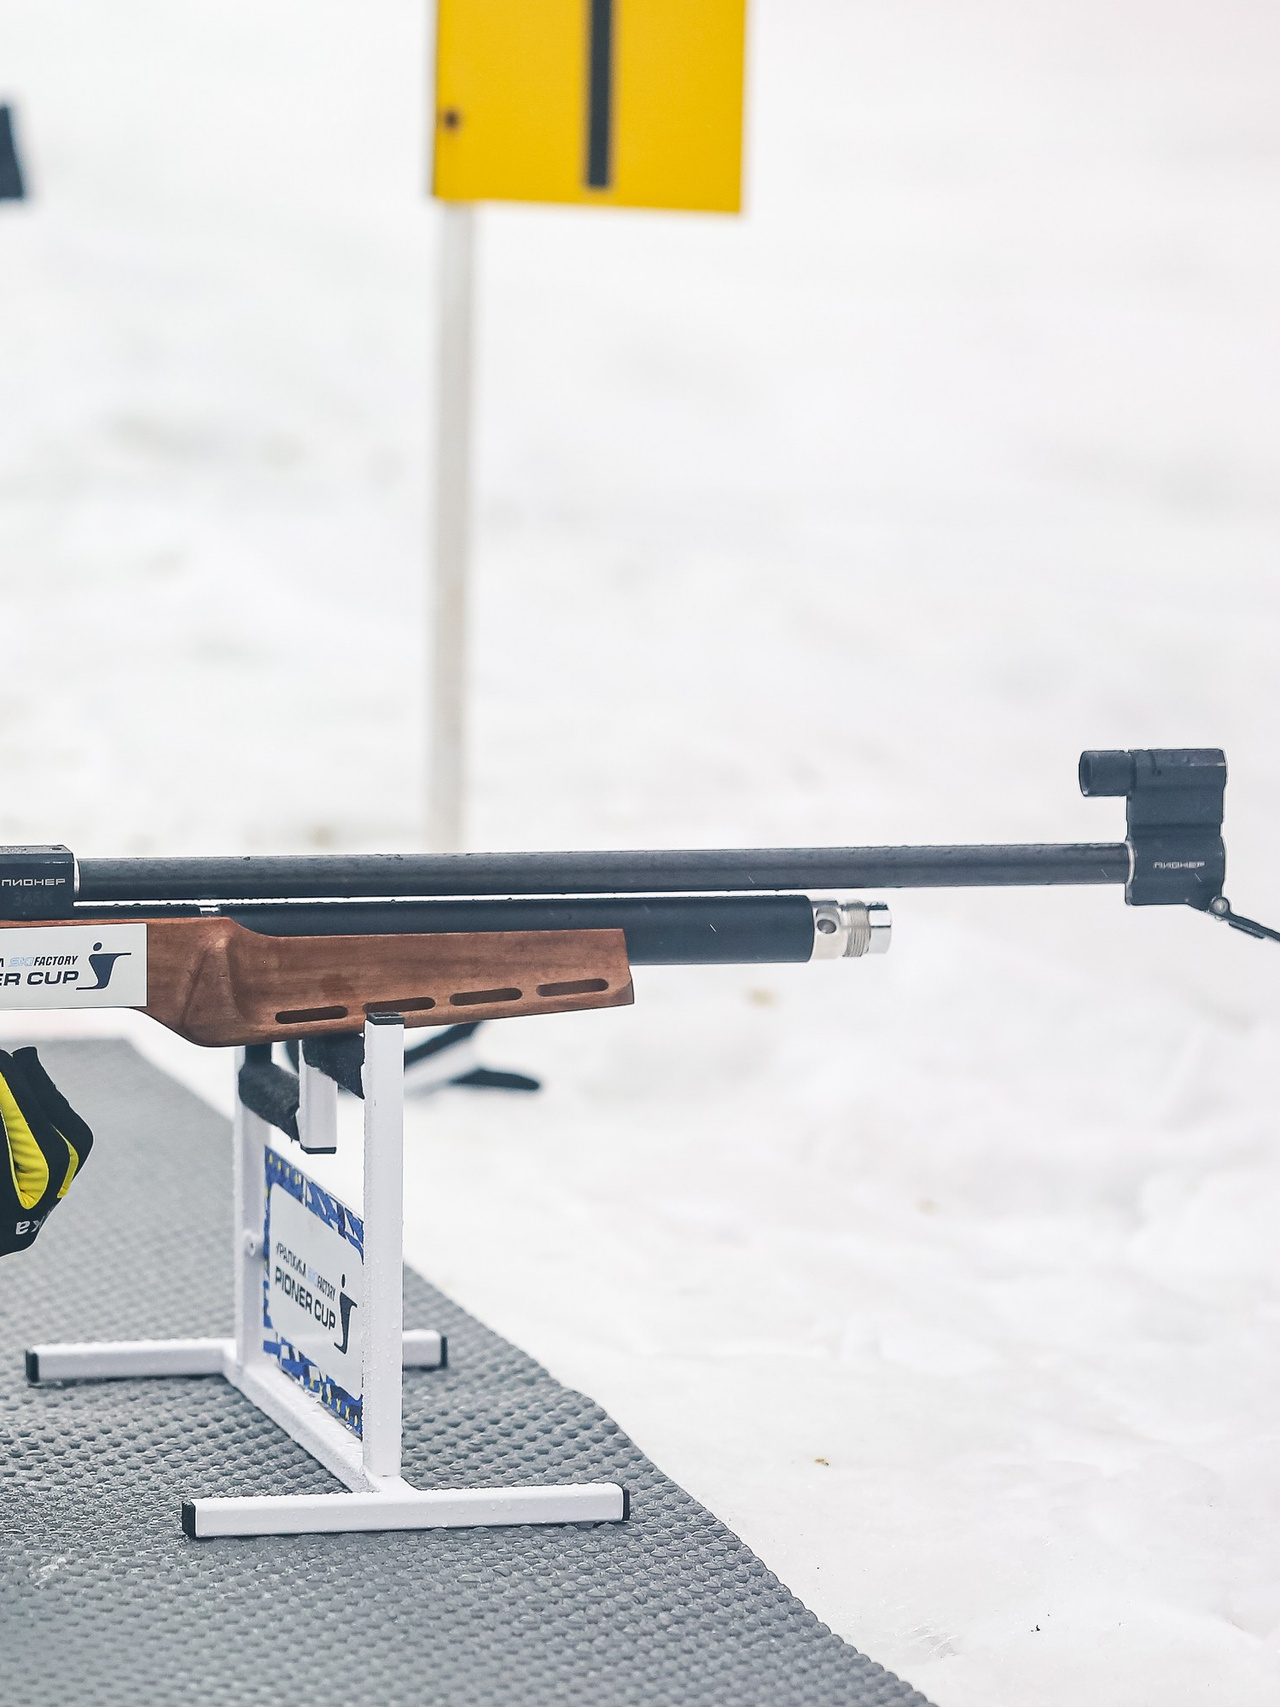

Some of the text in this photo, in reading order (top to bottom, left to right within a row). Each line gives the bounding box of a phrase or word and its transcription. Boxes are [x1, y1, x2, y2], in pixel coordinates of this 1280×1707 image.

[1, 877, 66, 887] ПИОНЕР
[26, 970, 80, 986] CUP
[275, 1265, 336, 1331] PIONER CUP
